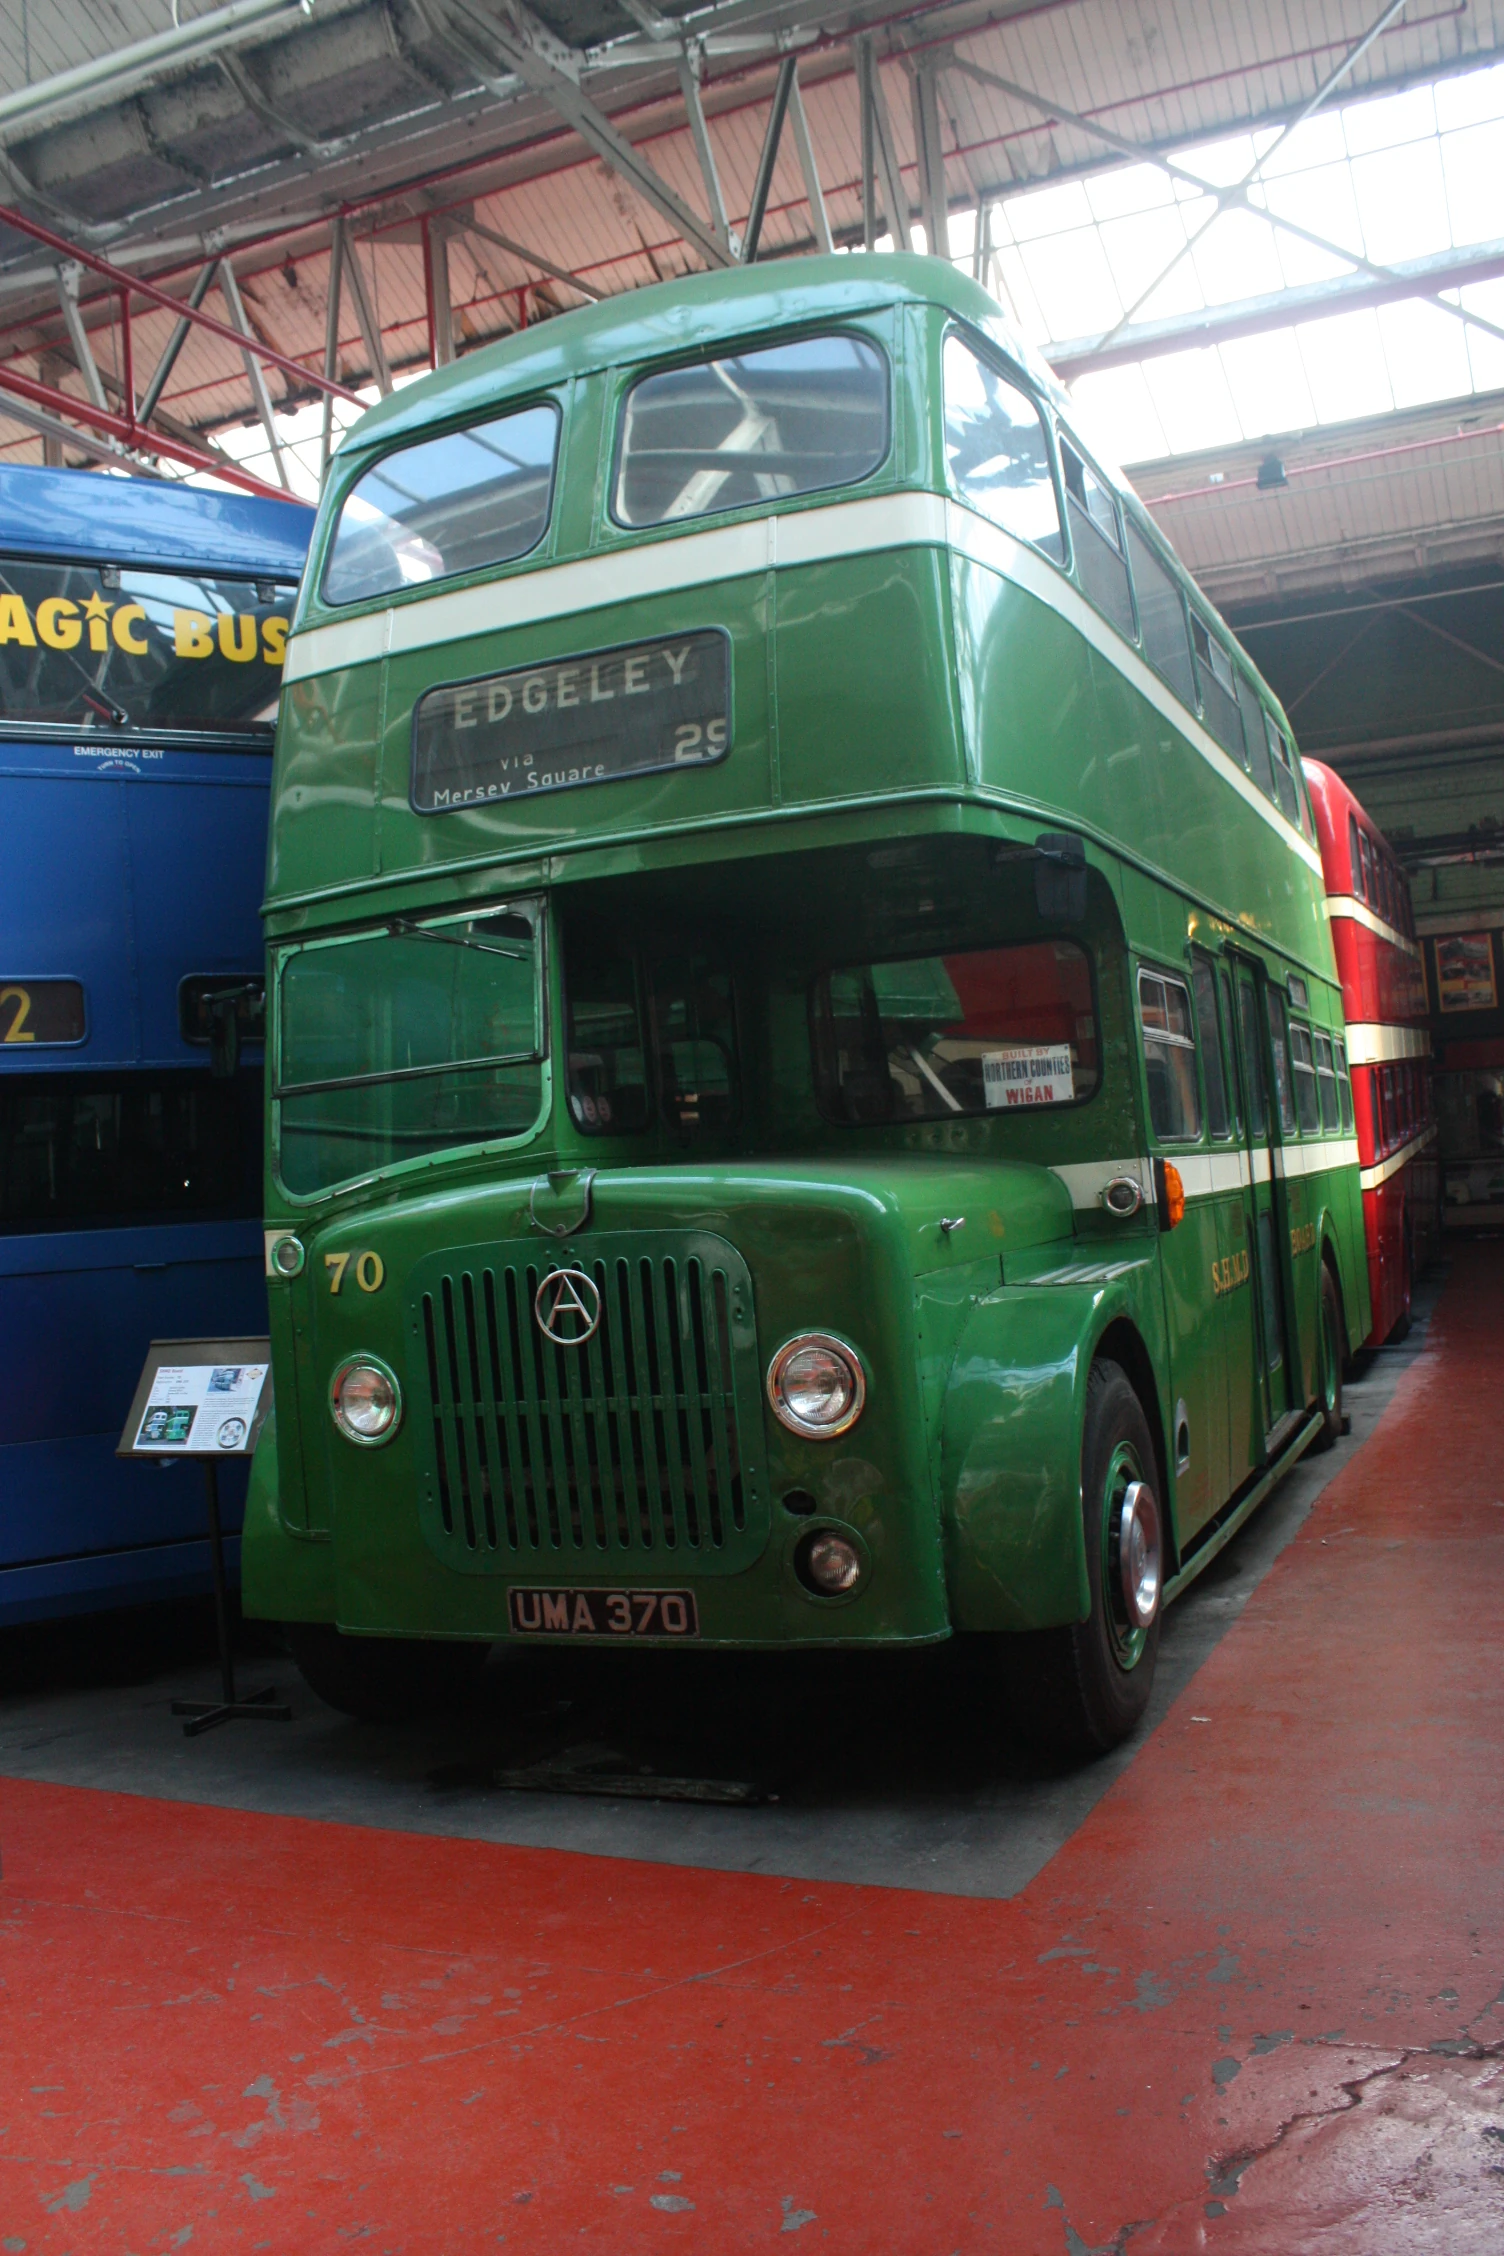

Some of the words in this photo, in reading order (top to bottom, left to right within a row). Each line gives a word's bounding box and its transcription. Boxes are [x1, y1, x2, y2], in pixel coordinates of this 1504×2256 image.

[173, 609, 289, 665] BUS
[454, 646, 691, 730] EDGELEY
[74, 746, 140, 758] EMERGENCY
[142, 748, 165, 759] EXIT
[500, 753, 534, 771] via
[0, 986, 35, 1043] 2
[984, 1060, 1028, 1083] NORTHERN
[1030, 1055, 1070, 1078] COUNTIES
[1002, 1048, 1033, 1060] BUILT
[1036, 1047, 1050, 1057] BY
[1005, 1084, 1054, 1105] WIGAN
[324, 1250, 385, 1295] 70
[516, 1592, 596, 1631] UMA
[606, 1594, 688, 1633] 370
